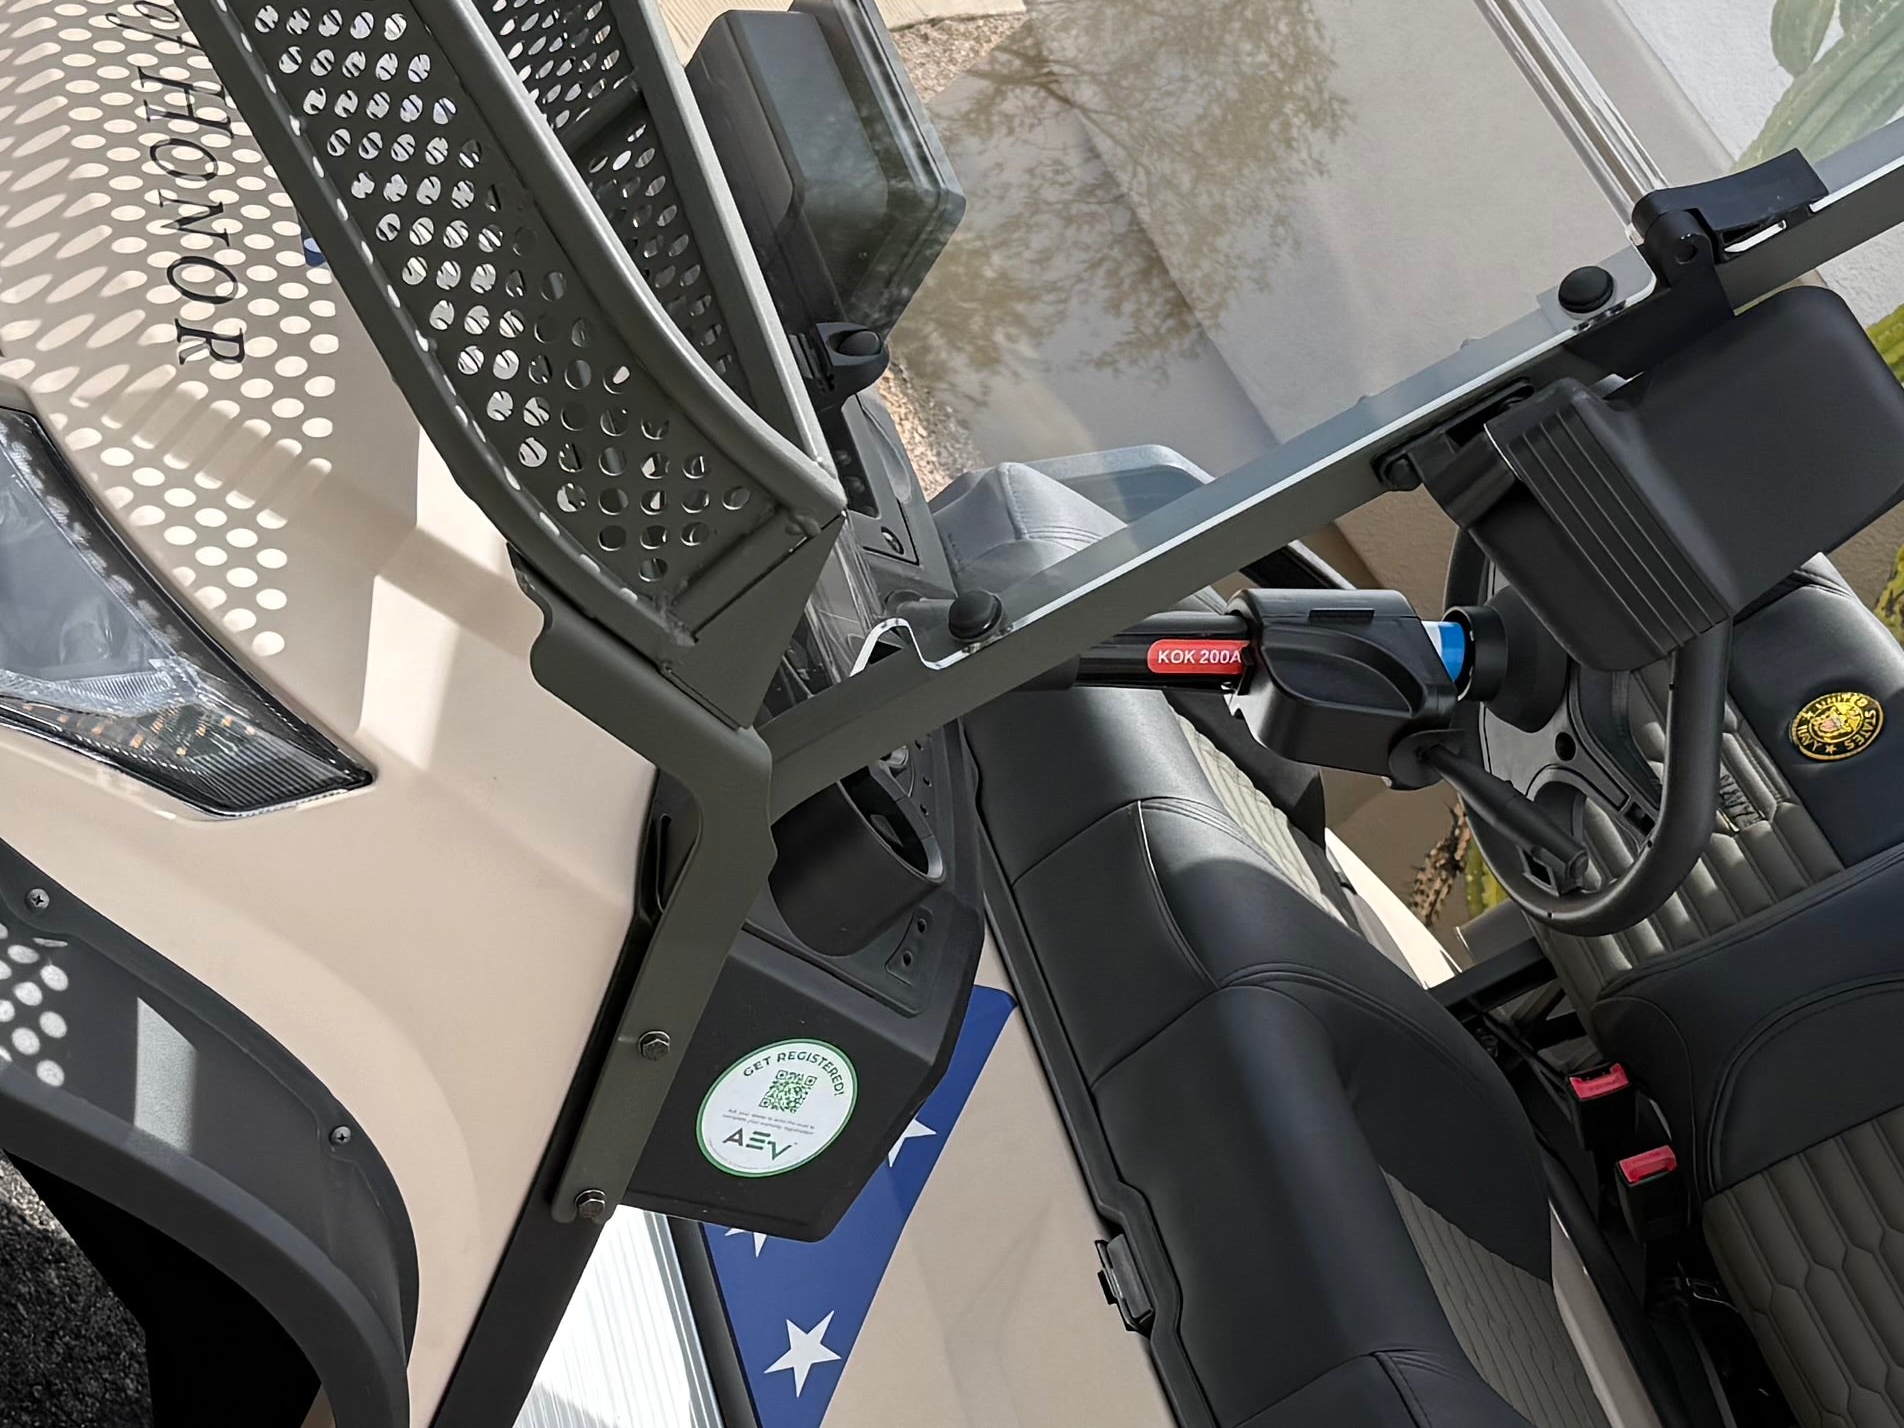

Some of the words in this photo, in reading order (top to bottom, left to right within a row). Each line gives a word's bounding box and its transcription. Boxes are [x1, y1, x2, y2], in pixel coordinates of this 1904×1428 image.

[135, 66, 247, 365] HONOR
[1158, 649, 1196, 664] KOK
[1199, 649, 1242, 664] 200A
[1844, 709, 1877, 750] STATES
[743, 1056, 772, 1077] GET
[776, 1051, 845, 1097] REGISTERED!
[722, 1127, 792, 1161] AEV
